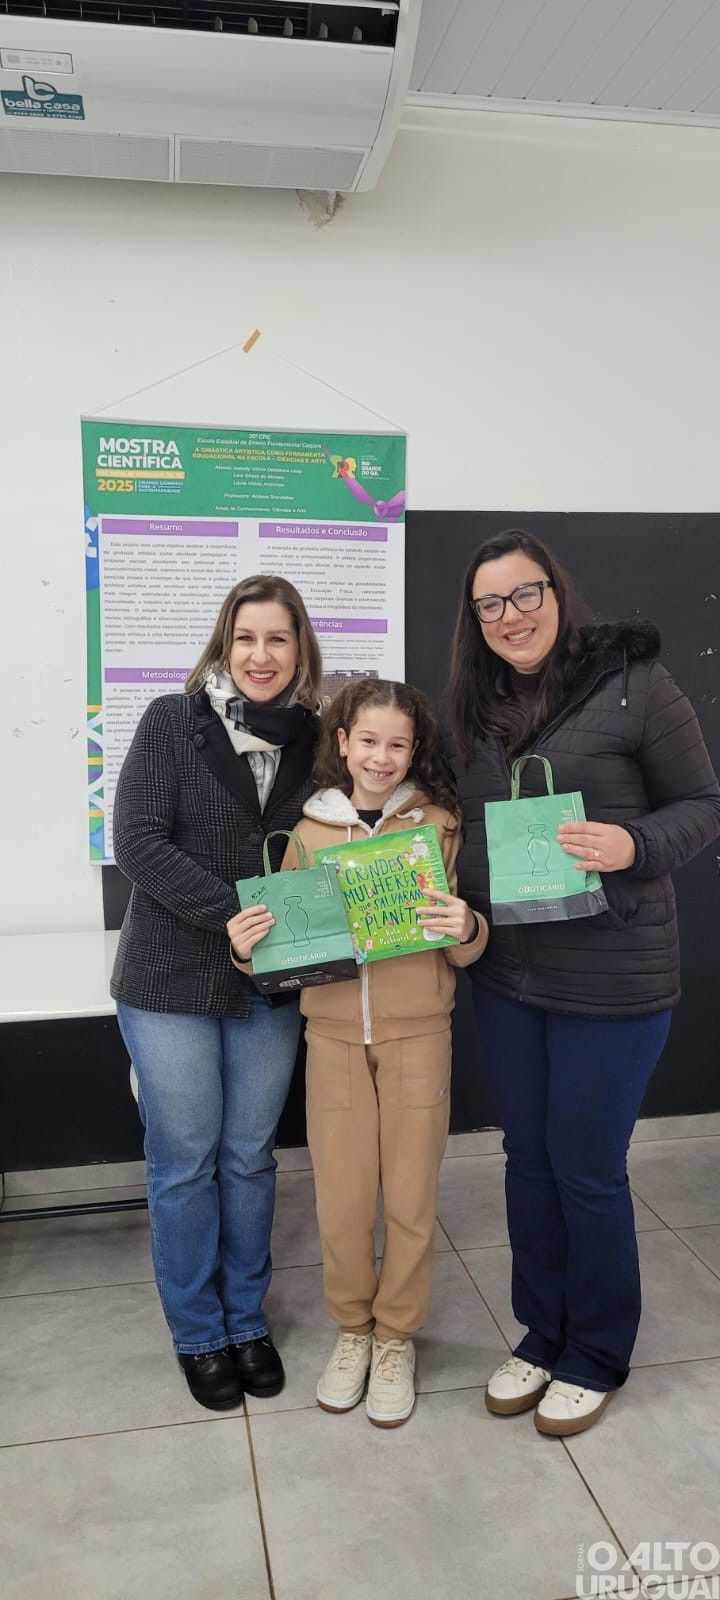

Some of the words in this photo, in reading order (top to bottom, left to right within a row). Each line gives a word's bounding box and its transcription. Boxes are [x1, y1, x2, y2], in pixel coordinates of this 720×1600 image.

[5, 98, 41, 109] bella
[99, 437, 180, 455] MOSTRA
[97, 453, 182, 469] CIENTÍFICA
[97, 479, 133, 492] 2025
[149, 523, 183, 531] Resumo
[276, 526, 320, 534] Resultados
[328, 527, 368, 537] Conclusão
[311, 620, 343, 628] erências
[142, 671, 191, 680] Metodologi
[342, 870, 416, 909] MULHERES
[374, 888, 425, 910] SALVARAM
